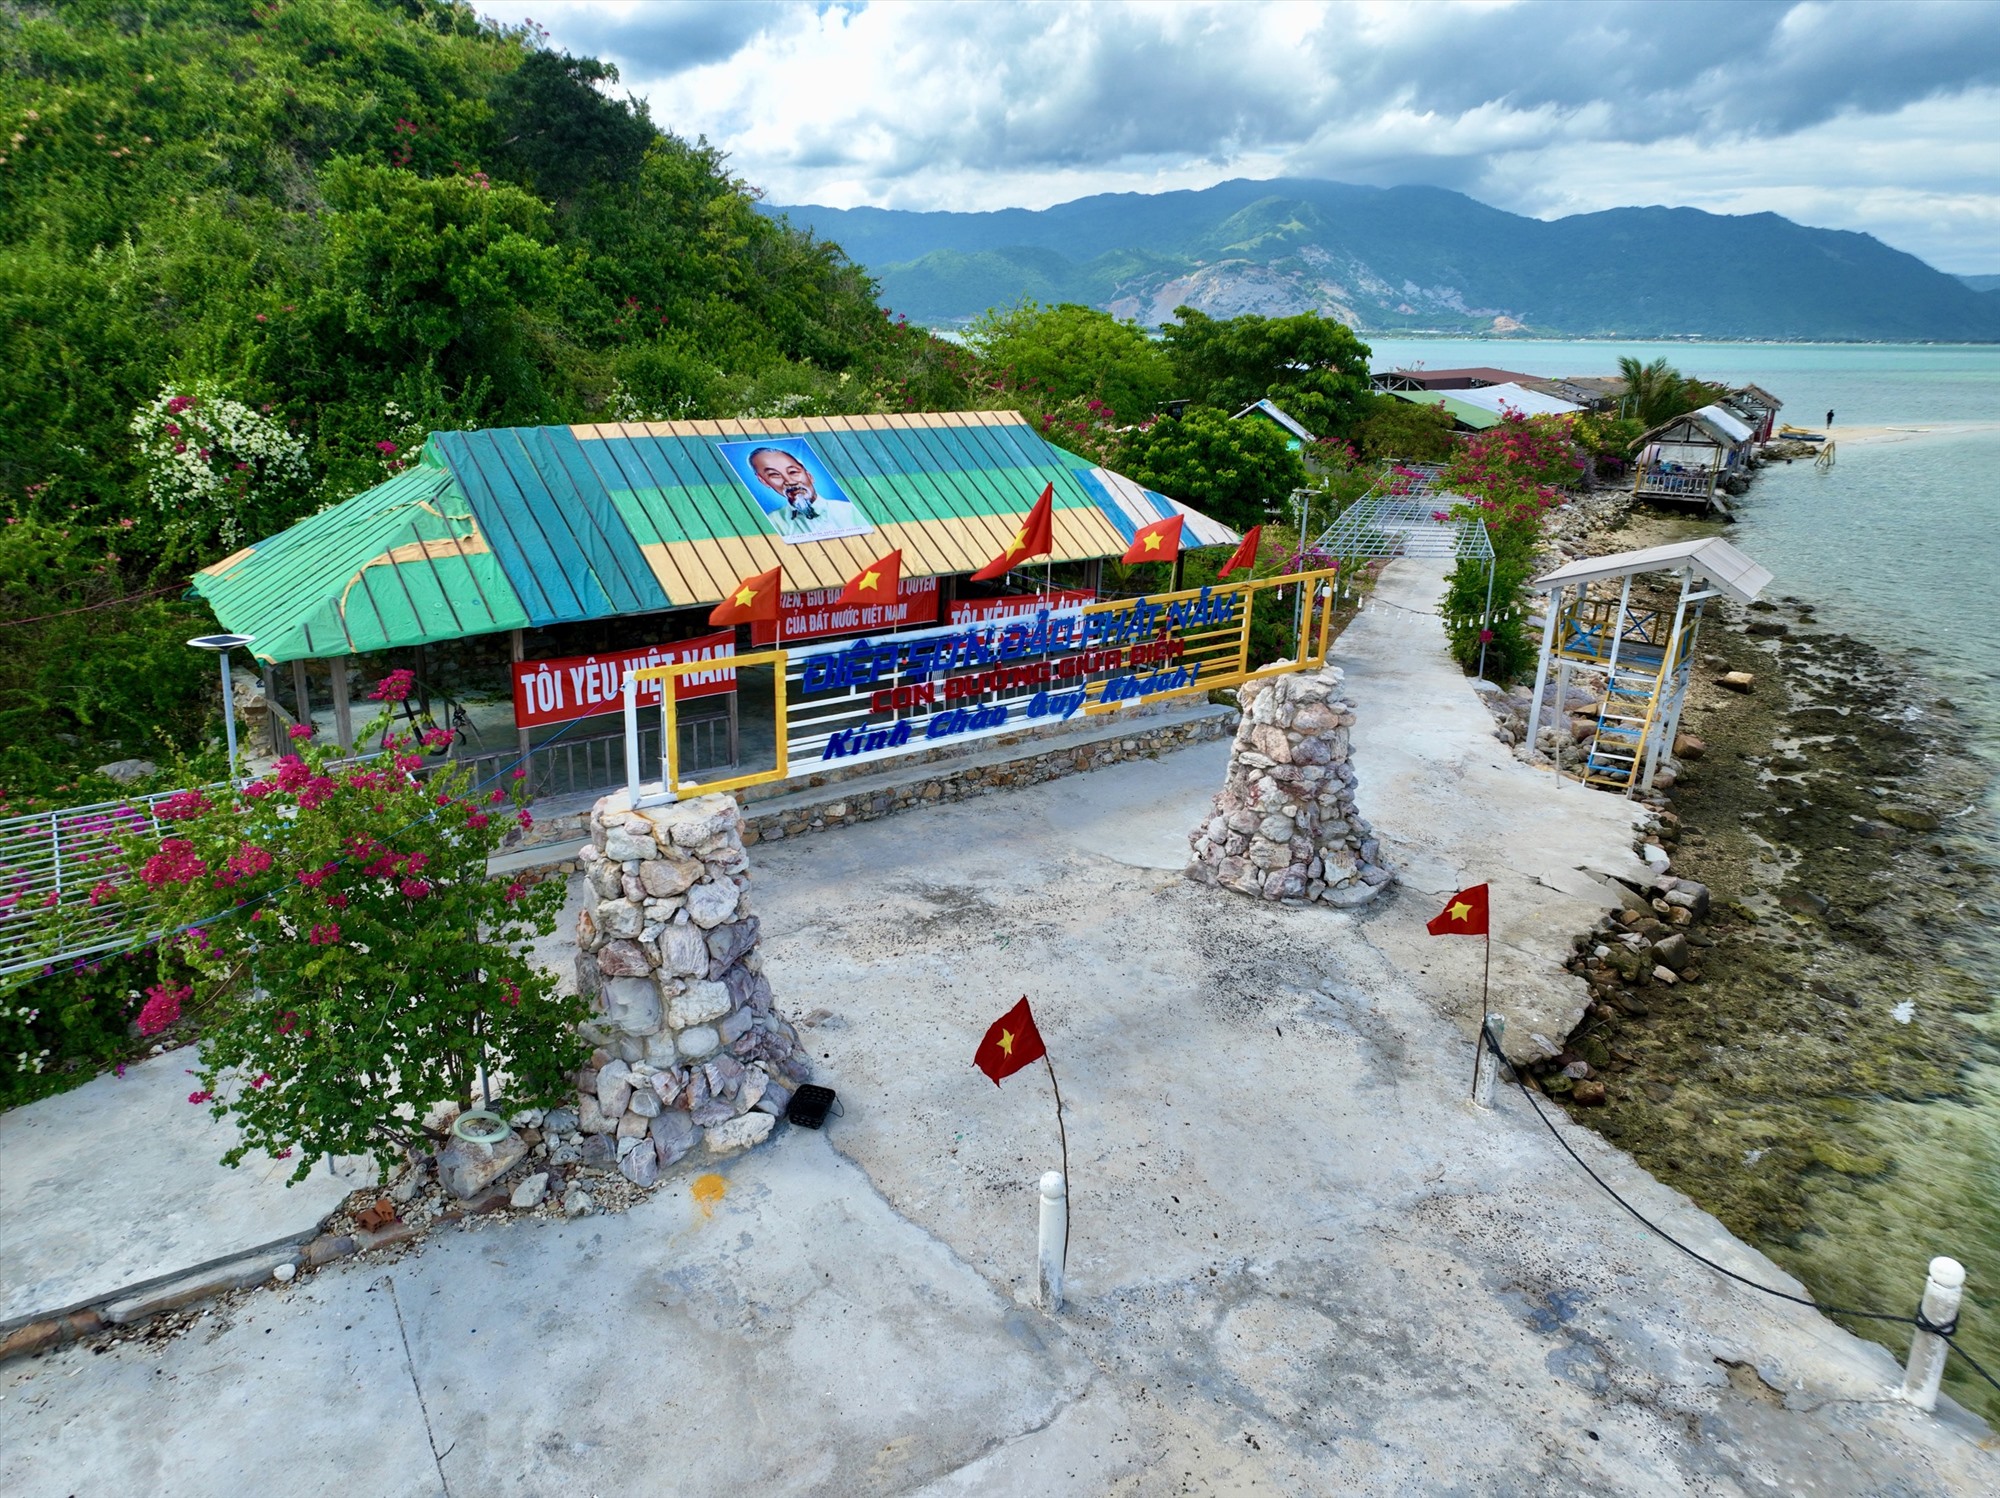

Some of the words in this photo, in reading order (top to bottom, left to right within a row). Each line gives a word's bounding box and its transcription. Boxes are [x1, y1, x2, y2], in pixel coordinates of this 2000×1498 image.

[785, 608, 807, 636] CỦA
[809, 607, 830, 631] ĐẤT
[831, 605, 859, 629] NƯỚC
[861, 603, 883, 628] VIỆT
[884, 603, 908, 621] NAM
[520, 663, 565, 715] TÔI
[569, 656, 619, 706] YÊU
[681, 642, 737, 688] NAM
[870, 682, 936, 714] CON
[943, 660, 1053, 701] ĐƯỜNG
[1058, 646, 1122, 679] GIỮA
[1130, 627, 1185, 665] BIỂN
[822, 719, 913, 761] Kính
[926, 702, 1008, 739] Chào
[1027, 681, 1087, 719] Quý
[1100, 661, 1201, 704] Khách!
